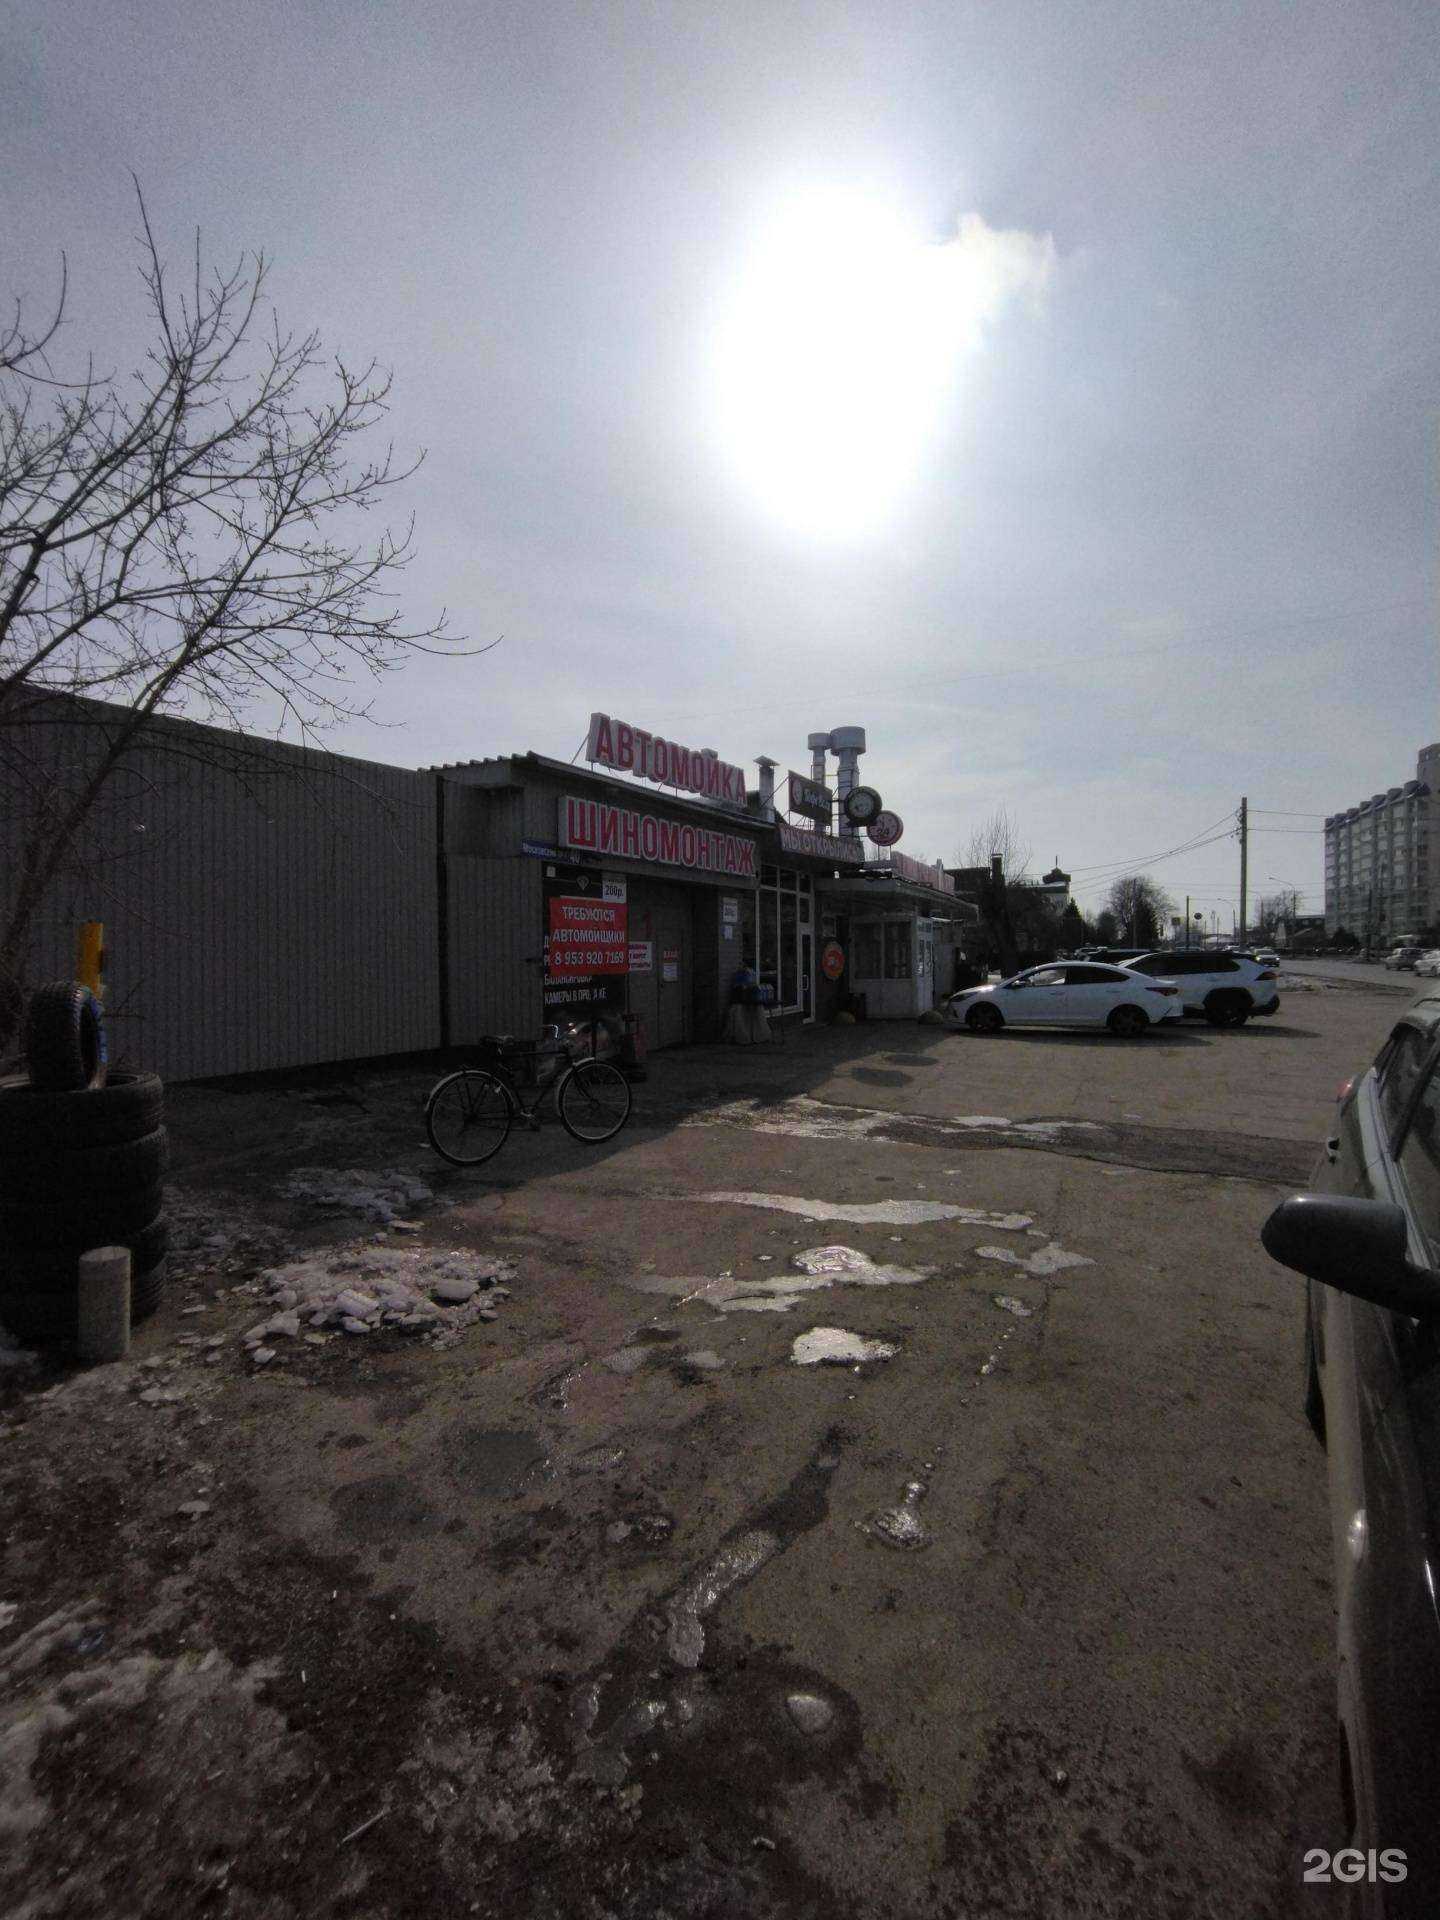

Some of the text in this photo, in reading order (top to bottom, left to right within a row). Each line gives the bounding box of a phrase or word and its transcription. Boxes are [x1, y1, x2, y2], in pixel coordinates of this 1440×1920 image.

[587, 713, 748, 807] АВТОМОЙКА
[566, 796, 756, 877] ШИНОМОНТАЖ
[562, 906, 616, 922] ТРЕБУЮТСЯ
[554, 952, 562, 966] 8
[565, 951, 584, 965] 953
[586, 951, 603, 964] 920
